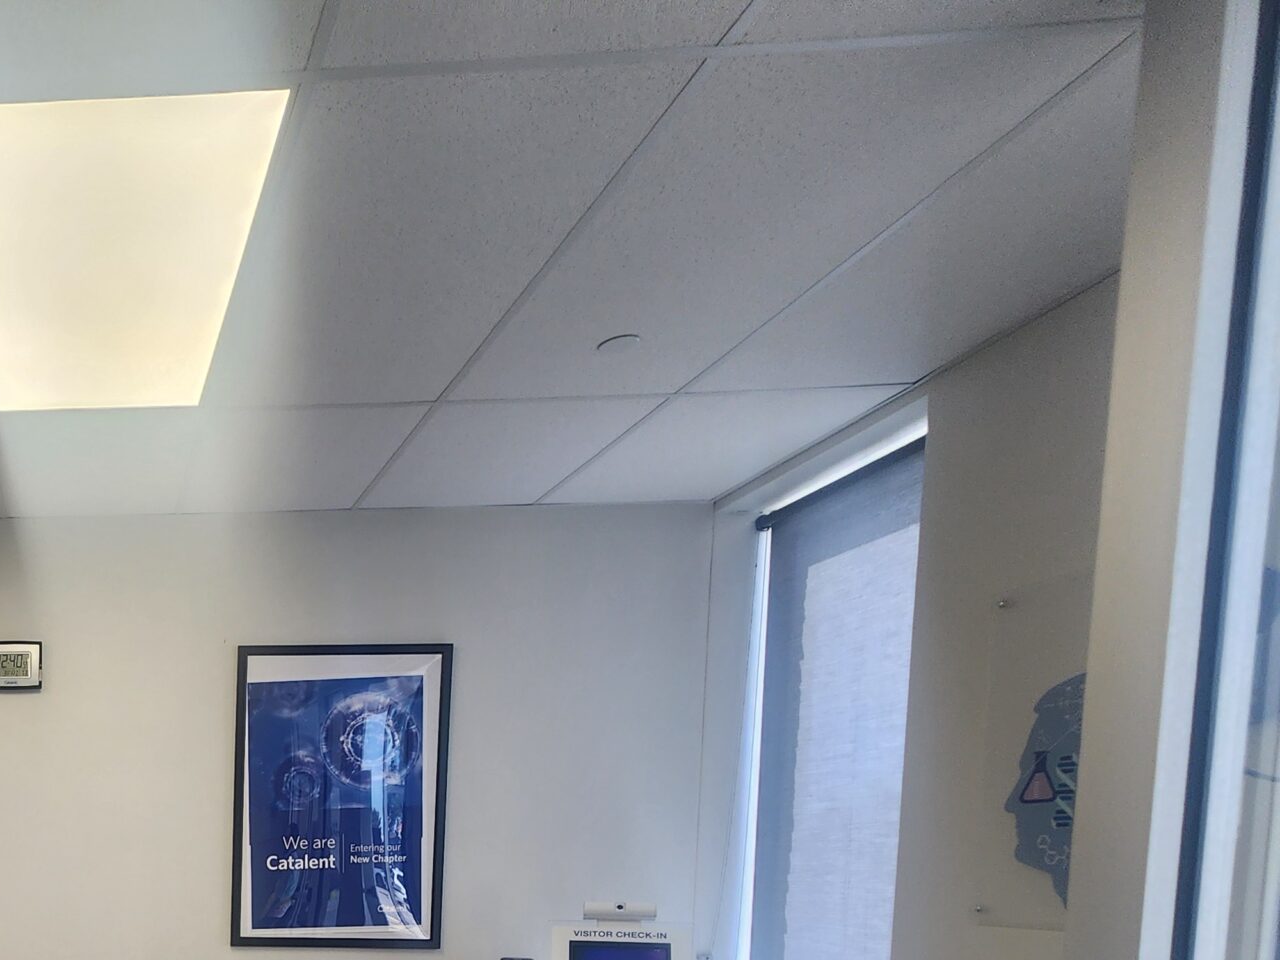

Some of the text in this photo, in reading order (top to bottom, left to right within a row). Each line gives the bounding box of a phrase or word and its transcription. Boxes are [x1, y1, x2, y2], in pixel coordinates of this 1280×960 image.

[282, 835, 336, 850] We are
[350, 843, 401, 853] Entering our
[266, 854, 336, 871] Catalent
[350, 854, 407, 865] New Chapter
[573, 930, 668, 939] VISITOR CHECK-IN
